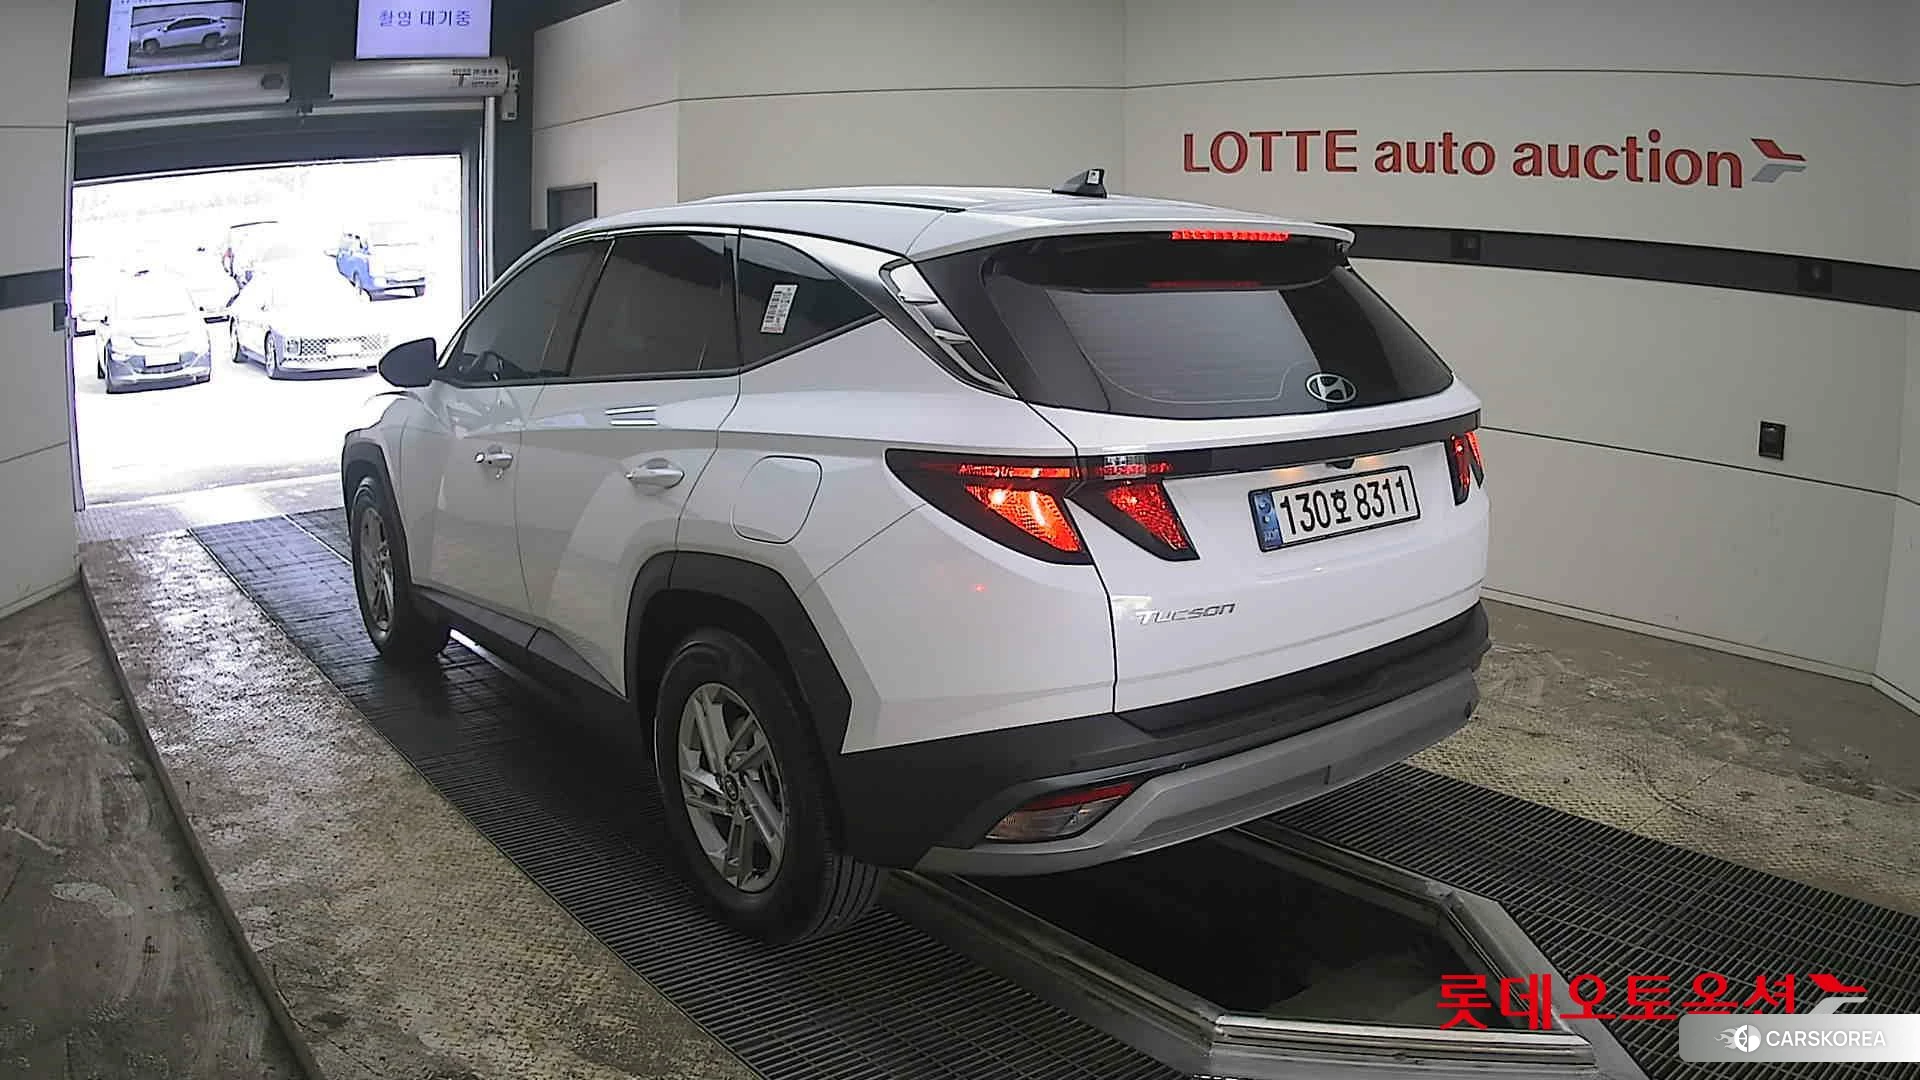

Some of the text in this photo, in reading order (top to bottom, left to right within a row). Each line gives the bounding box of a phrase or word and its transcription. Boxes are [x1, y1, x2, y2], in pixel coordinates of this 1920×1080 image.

[420, 9, 471, 27] 대기중
[1183, 128, 1743, 188] LOTTE auto auction
[1280, 475, 1409, 535] 130호 8311
[1136, 603, 1236, 625] TUCSON
